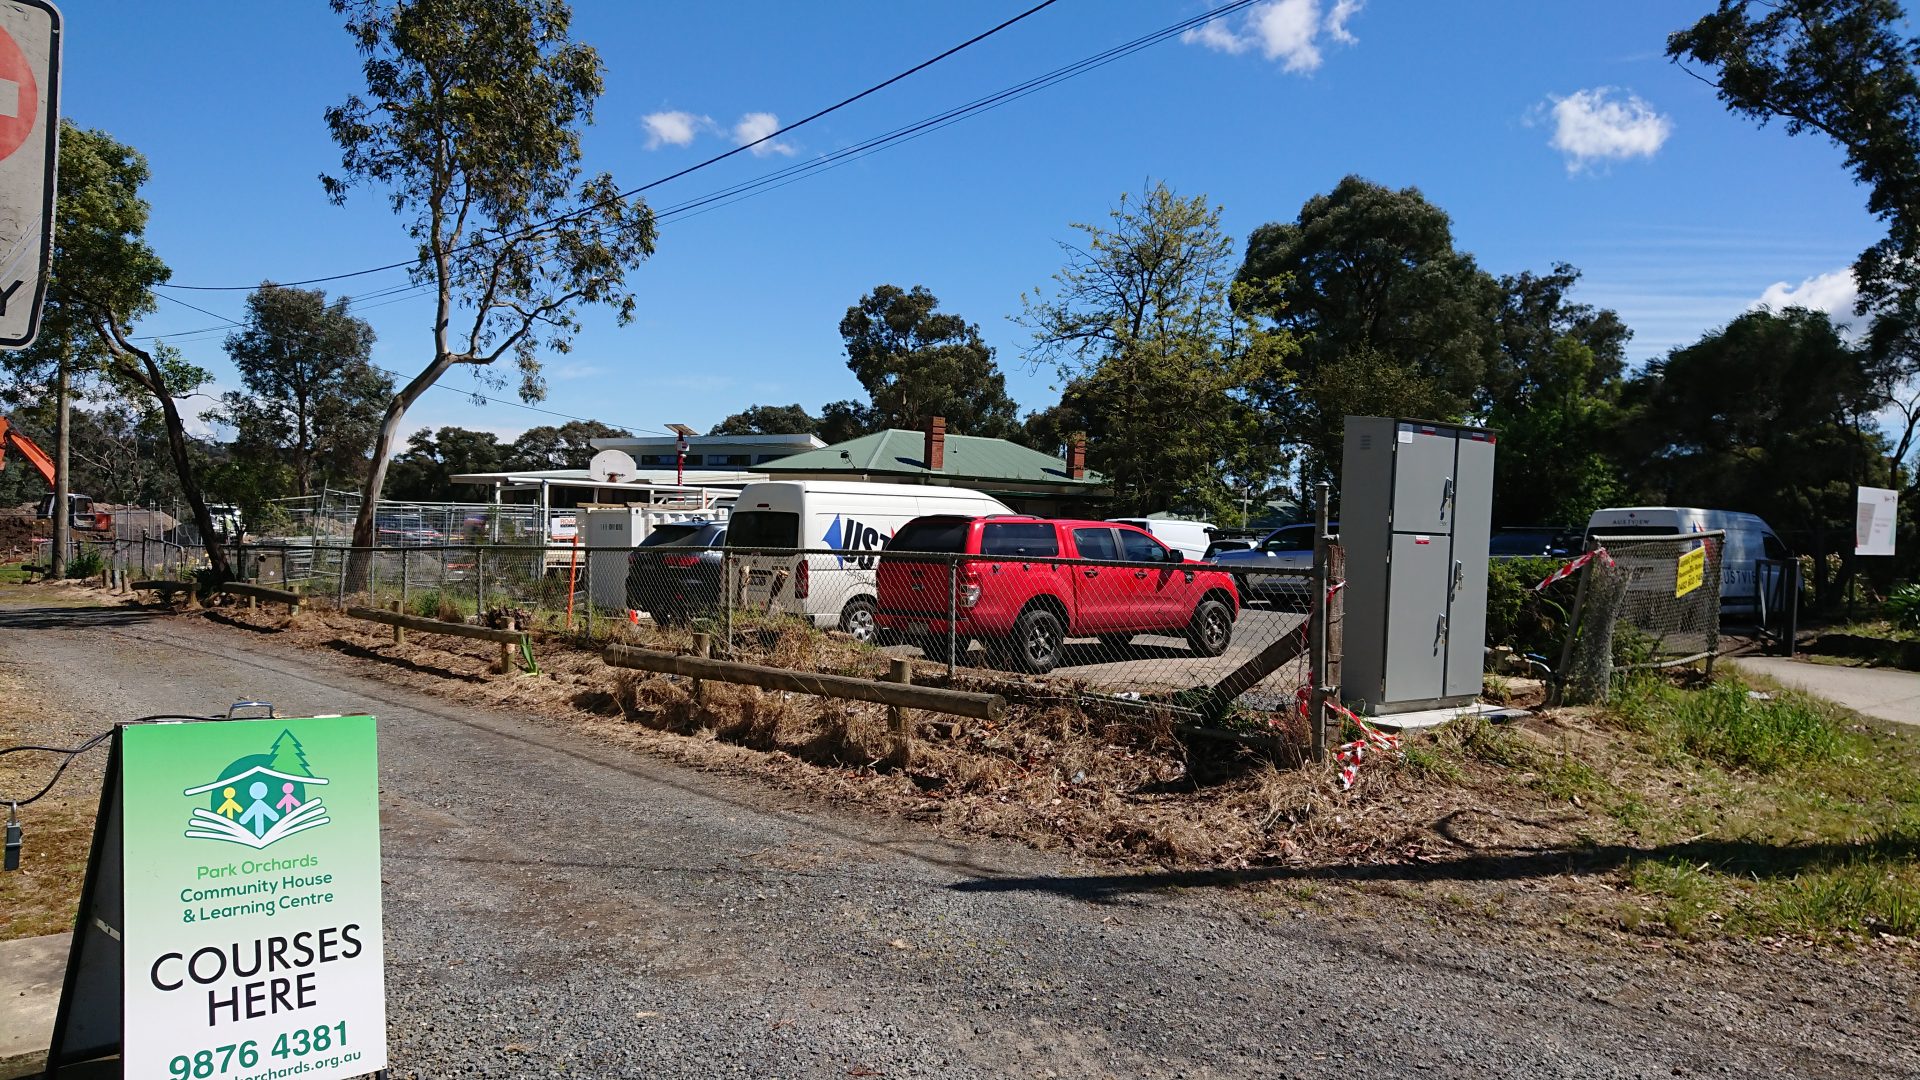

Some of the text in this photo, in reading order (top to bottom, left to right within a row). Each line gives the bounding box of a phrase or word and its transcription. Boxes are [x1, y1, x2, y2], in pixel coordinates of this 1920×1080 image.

[180, 873, 333, 903] Community House
[197, 854, 318, 880] Park Orchards
[183, 892, 334, 923] & Learning Centre
[150, 923, 362, 991] COURSES
[208, 972, 317, 1026] HERE
[169, 1020, 347, 1080] 9876 4381
